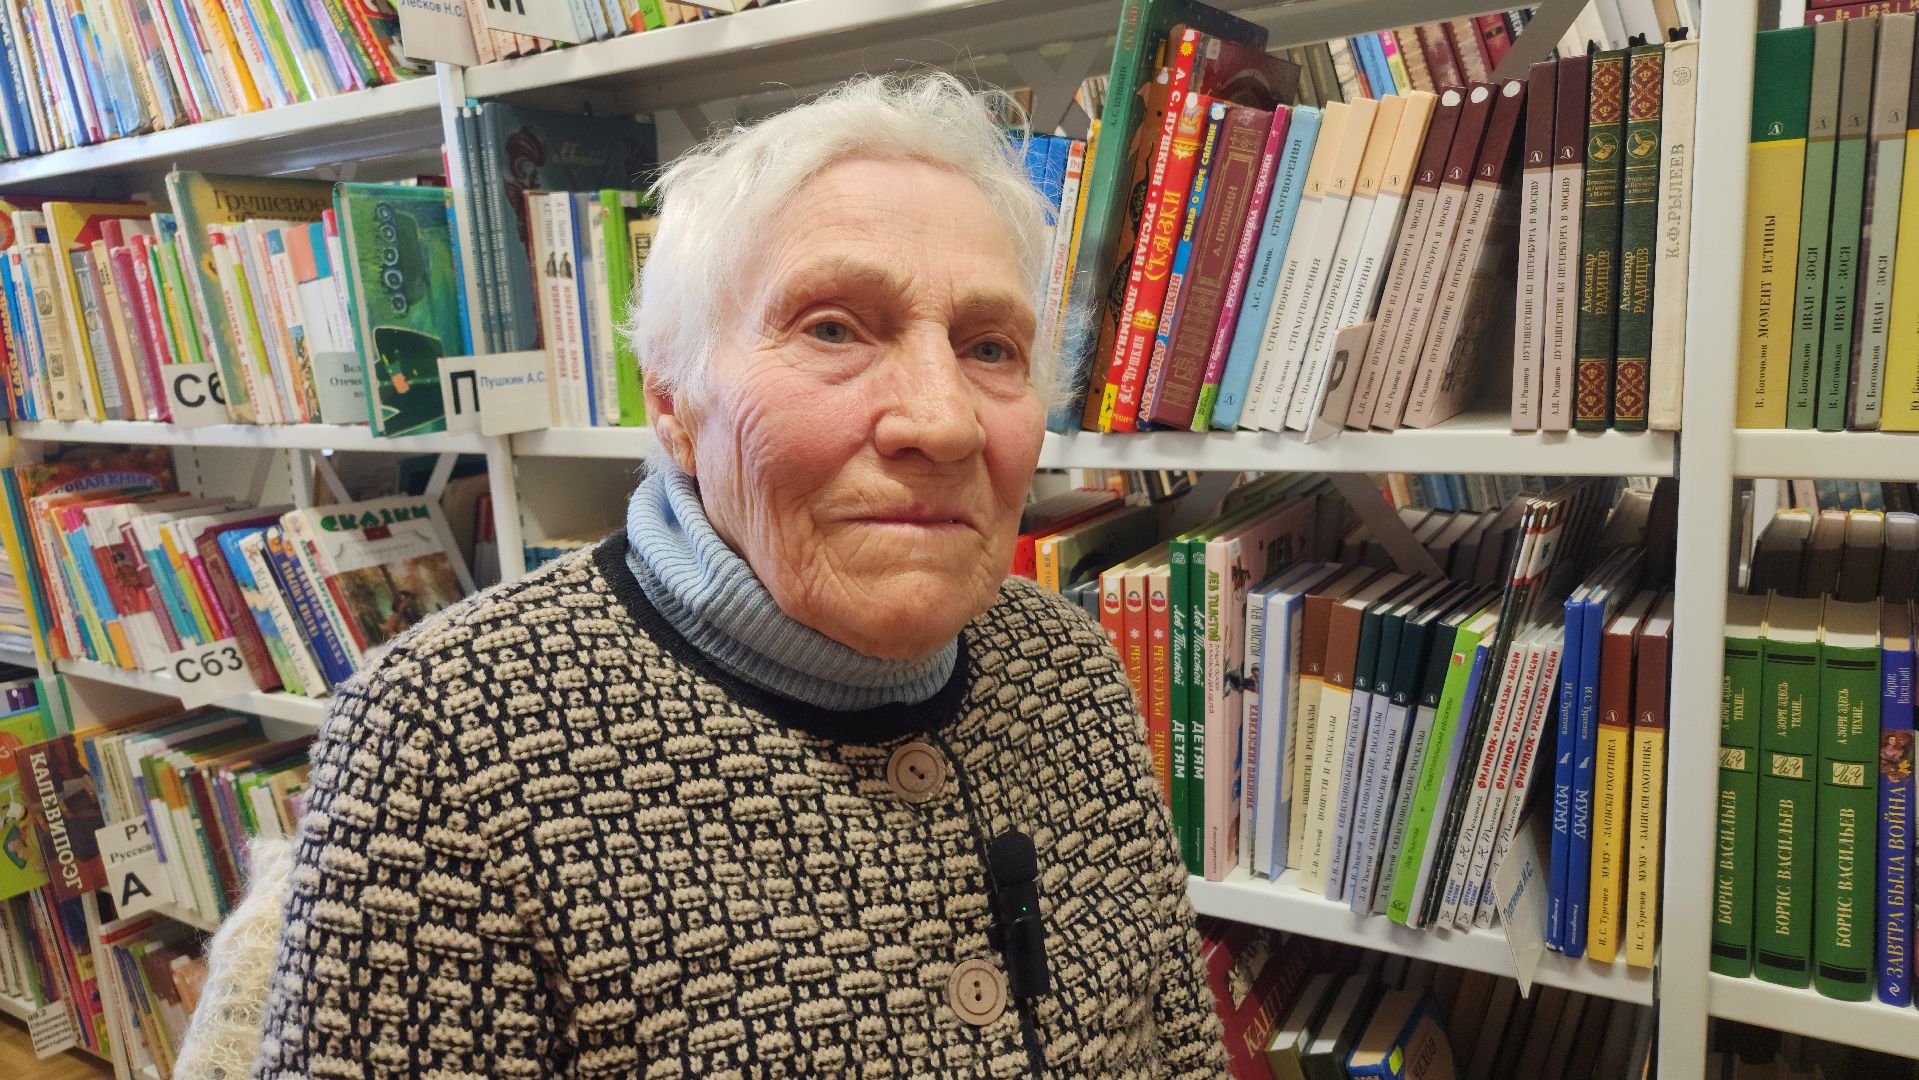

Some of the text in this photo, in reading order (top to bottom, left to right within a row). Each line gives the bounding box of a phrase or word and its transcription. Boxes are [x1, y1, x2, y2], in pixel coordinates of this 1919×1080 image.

[1169, 90, 1181, 107] С.
[1152, 111, 1177, 186] ПУШКИН
[1202, 123, 1217, 165] САЛТАНЕ
[1270, 139, 1303, 236] СТИХОТВОРЕНИЯ
[1530, 179, 1540, 215] МОСКВУ
[1560, 176, 1571, 212] МОСКВУ
[1136, 203, 1157, 266] РУСЛАН
[1225, 272, 1241, 309] РУСЛАН
[1256, 153, 1273, 195] СКАЗКИ
[1526, 227, 1537, 280] ПЕТЕРБУРГА
[1557, 224, 1569, 278] ПЕТЕРБУРГА
[1131, 271, 1142, 282] И
[1266, 260, 1298, 352] СТИХОТВОРЕНИЯ
[1288, 258, 1321, 352] СТИХОТВОРЕНИЯ
[1314, 257, 1348, 352] СТИХОТВОРЕНИЯ
[1372, 307, 1394, 366] ПУТЕШЕСТВИЕ
[1394, 242, 1414, 292] ПЕТЕРБУРГА
[1411, 196, 1425, 232] МОСКВУ
[1398, 305, 1420, 365] ПУТЕШЕСТВИЕ
[1420, 240, 1440, 291] ПЕТЕРБУРГА
[1440, 194, 1453, 228] МОСКВУ
[1429, 304, 1452, 363] ПУТЕШЕСТВИЕ
[1452, 237, 1472, 288] ПЕТЕРБУРГА
[1470, 192, 1485, 225] МОСКВУ
[1581, 253, 1598, 313] Александр
[1595, 250, 1610, 315] РАДИЩЕВ
[1619, 251, 1636, 311] Александр
[1633, 248, 1649, 314] РАДИЩЕВ
[1758, 215, 1776, 394] Богомолов МОМЕНТ ИСТИНЫ
[564, 286, 578, 345] ИЗБРАННОЕ
[571, 349, 580, 380] ПРОЗА
[1112, 285, 1138, 367] ЛЮДМИЛА
[1139, 273, 1183, 421] АЛЕКСАНДР ПУШКИН
[1522, 298, 1533, 361] ПУТЕШЕСТВИЕ
[1553, 296, 1565, 361] ПУТЕШЕСТВИЕ
[1798, 247, 1818, 394] Богомолов ИВАН ЗОСЯ
[1830, 246, 1850, 395] Богомолов ИВАН ЗОСЯ
[1867, 255, 1888, 398] Богомолов ИВАН ЗОСЯ
[450, 370, 480, 415] П
[480, 374, 521, 388] Пушкин
[558, 349, 567, 379] ПРОЗА
[320, 504, 431, 532] СКАЗКИ
[1208, 569, 1220, 642] ЛЕВ ТОЛСТОЙ
[1250, 605, 1263, 656] ЛЕВ ТОЛСТОЙ
[1154, 645, 1164, 716] РАССКАЗЫ
[1173, 631, 1186, 686] Толстой
[1247, 704, 1258, 764] КАВКАЗСКИЙ
[1306, 704, 1316, 749] РАССКАЗЫ
[1477, 652, 1521, 789] ФИЛИПОК РАССКАЗЫ БАСНИ
[1496, 652, 1539, 790] ФИЛИПОК РАССКАЗЫ БАСНИ
[1514, 651, 1558, 789] ФИЛИПОК РАССКАЗЫ БАСНИ
[1778, 682, 1789, 729] ЗОРИ ЗДЕСЬ
[1838, 688, 1849, 736] ЗОРИ ЗДЕСЬ
[1172, 720, 1185, 778] ДЕТЯМ
[1192, 720, 1204, 779] ДЕТЯМ
[1319, 716, 1337, 821] ПОВЕСТИ РАССКАЗЫ
[1338, 706, 1360, 828] СЕВАСТОПОЛЬСКИЕ РАССКАЗЫ
[1359, 711, 1382, 833] СЕВАСТОПОЛЬСКИЕ РАССКАЗЫ
[1607, 738, 1616, 792] ОХОТНИКА
[1643, 740, 1652, 795] ОХОТНИКА
[30, 751, 83, 890] КАЛЕВИПОЭГ
[1370, 729, 1396, 850] СЕВАСТОПОЛЬСКИЕ РАССКАЗЫ
[1393, 730, 1425, 850] СЕВАСТОПОЛЬСКИЕ РАССКАЗЫ
[1555, 784, 1569, 834] МУМУ
[1574, 789, 1588, 840] МУМУ
[1604, 796, 1614, 838] ЗАПИСКИ
[1640, 799, 1650, 841] ЗАПИСКИ
[125, 820, 151, 841] Р1
[1718, 790, 1736, 925] БОРИС ВАСИЛЬЕВ
[121, 871, 152, 907] А
[1776, 799, 1794, 936] БОРИС ВАСИЛЬЕВ
[1836, 808, 1855, 948] БОРИС ВАСИЛЬЕВ
[1884, 787, 1905, 978] ЗАВТРА БЫЛА ВОЙНА
